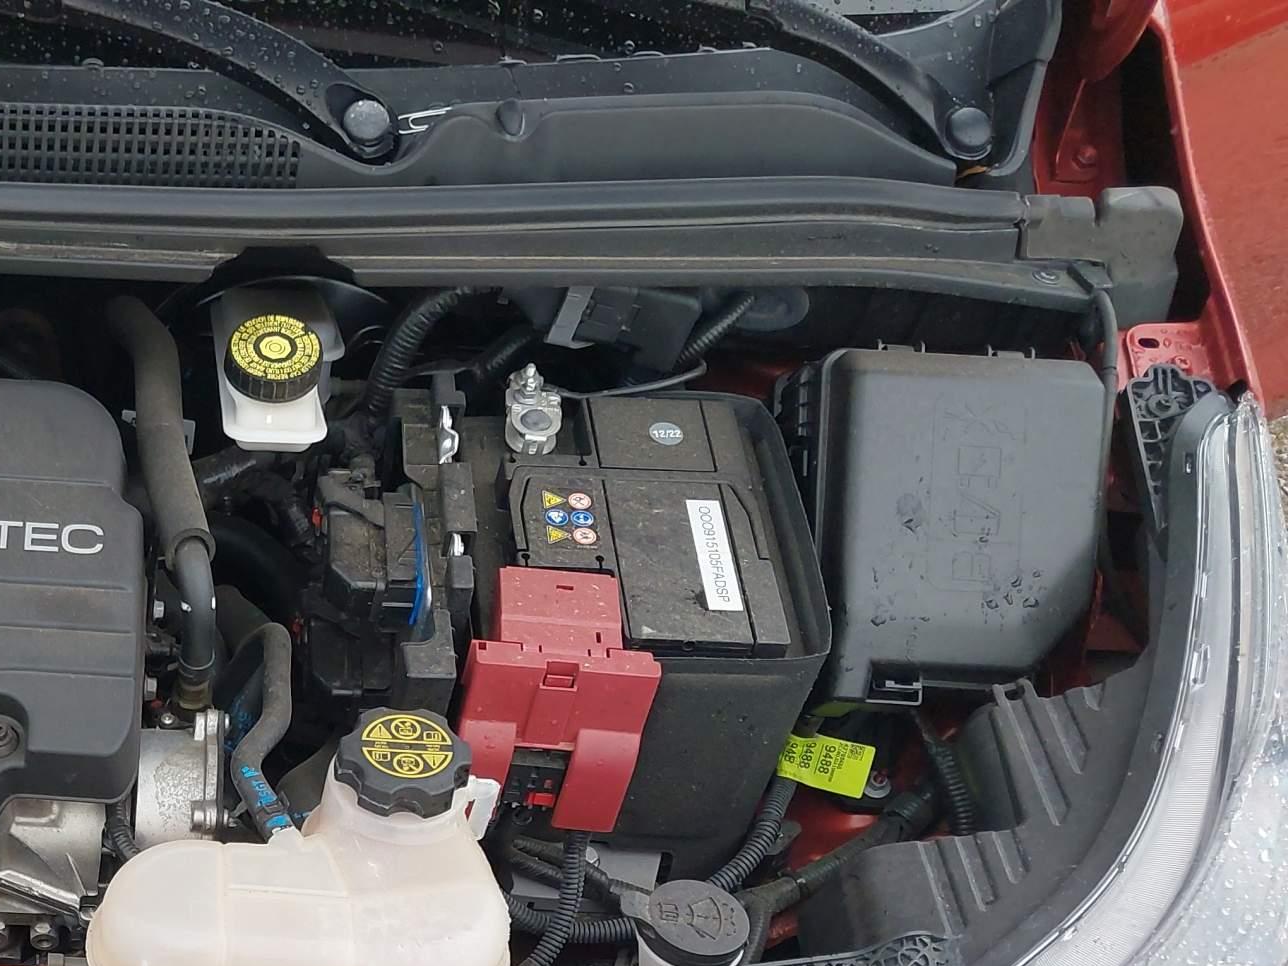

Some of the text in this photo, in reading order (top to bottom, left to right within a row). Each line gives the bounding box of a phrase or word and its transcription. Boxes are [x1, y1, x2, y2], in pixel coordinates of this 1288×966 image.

[651, 428, 683, 440] 12/22
[799, 742, 817, 769] 9488
[817, 744, 837, 775] 9488
